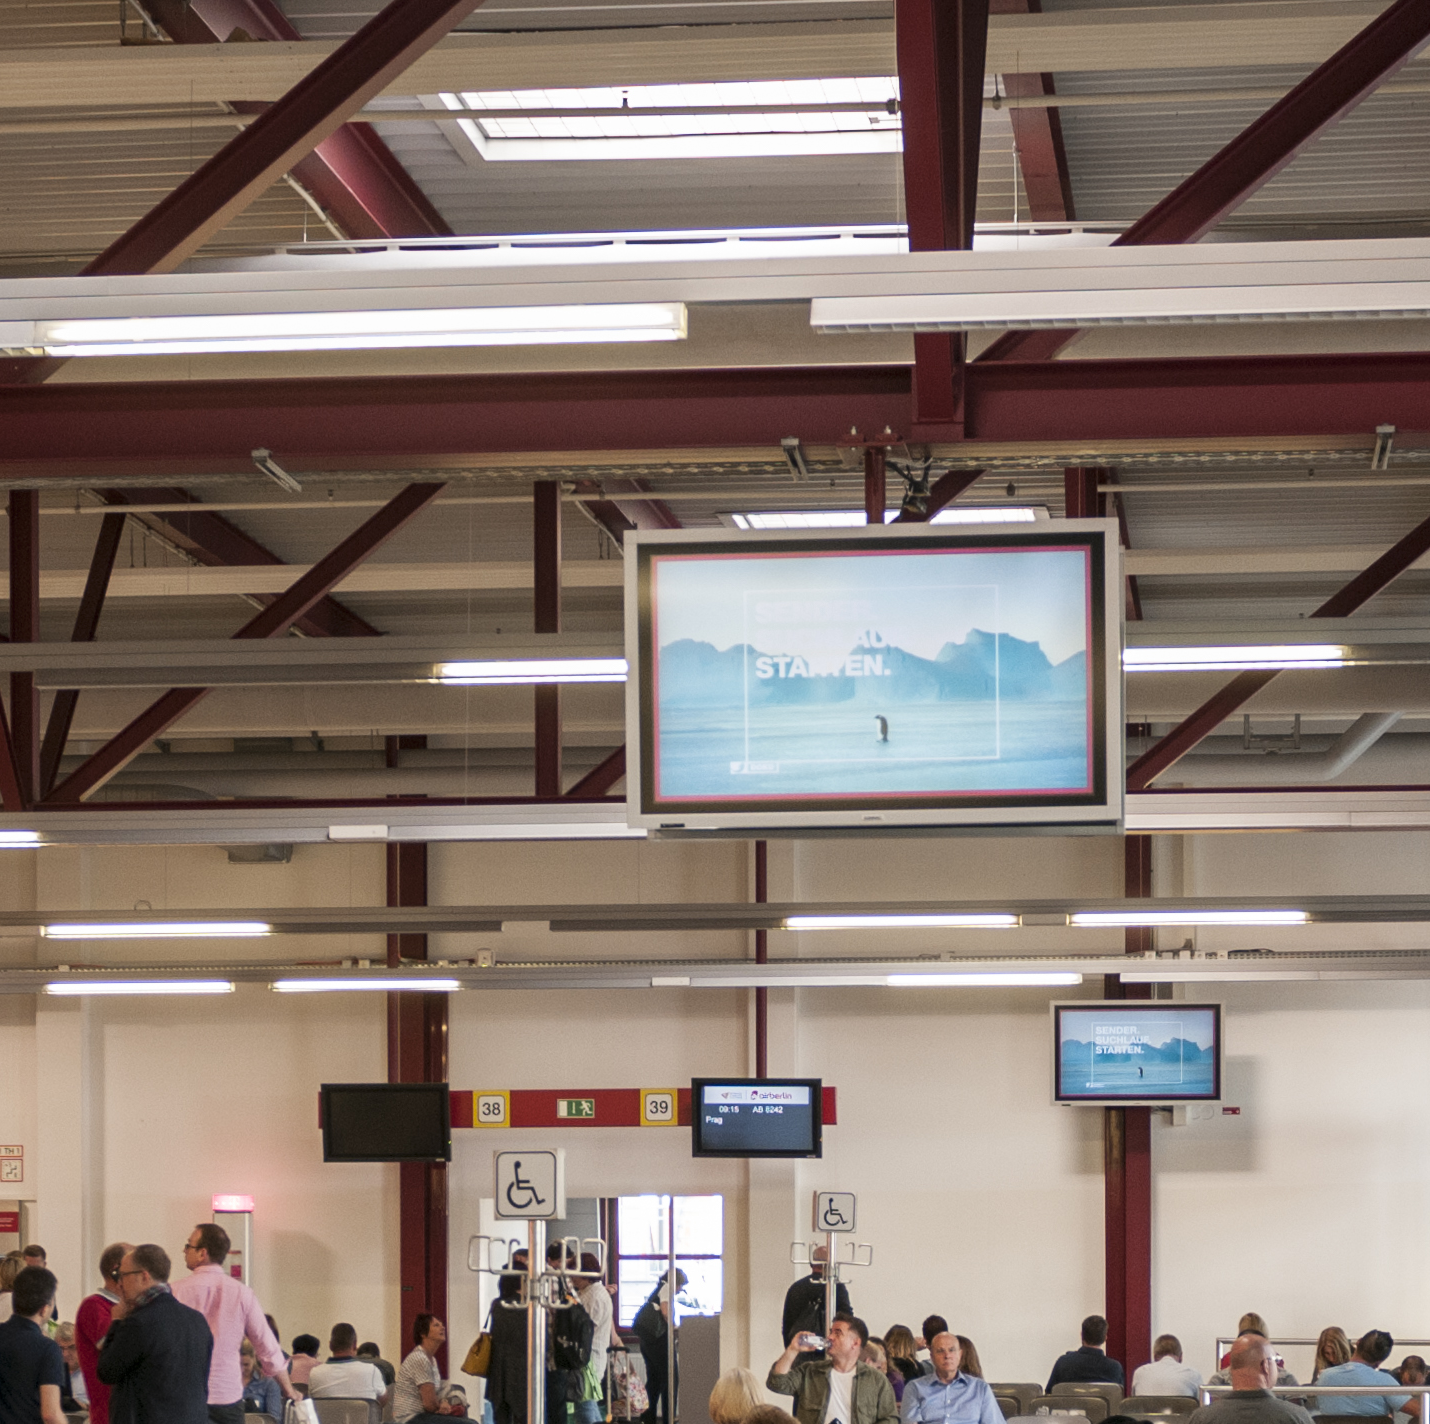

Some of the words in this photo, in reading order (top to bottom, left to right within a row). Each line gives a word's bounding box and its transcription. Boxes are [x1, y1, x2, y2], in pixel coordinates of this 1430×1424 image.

[1096, 1026, 1140, 1034] SENDER.
[1096, 1035, 1151, 1044] SUCHLAUF.
[1096, 1045, 1144, 1054] STARTEN.
[759, 1091, 793, 1100] airberlin
[481, 1102, 501, 1116] 38
[649, 1100, 669, 1115] 39
[752, 1105, 764, 1113] AB
[705, 1116, 723, 1125] Prag
